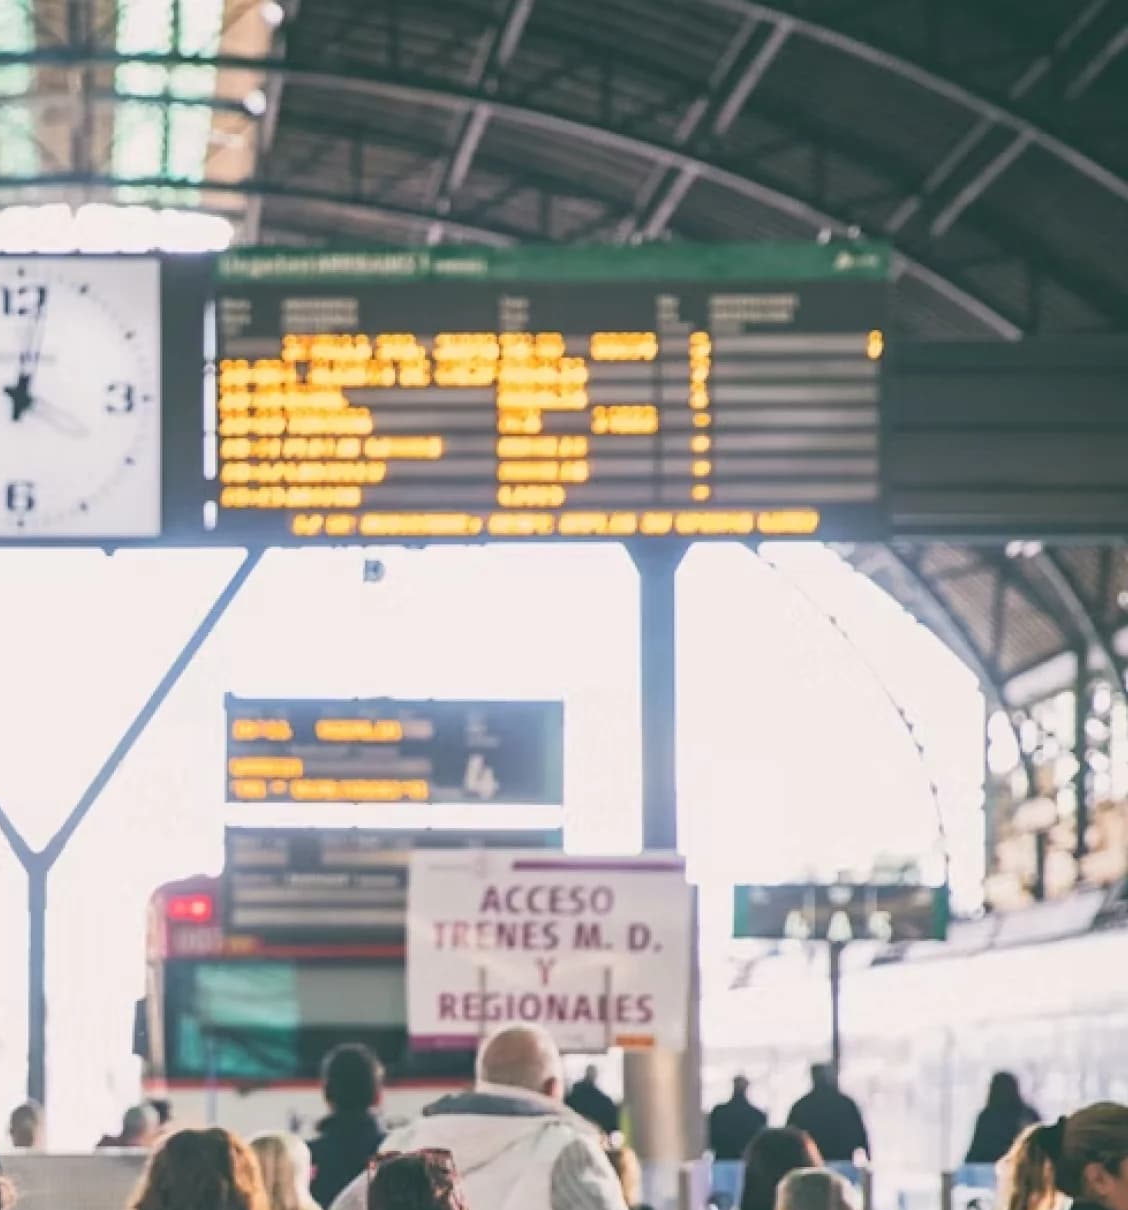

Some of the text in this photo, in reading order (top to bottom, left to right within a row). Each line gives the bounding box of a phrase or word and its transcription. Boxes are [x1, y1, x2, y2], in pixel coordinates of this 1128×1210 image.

[0, 286, 47, 316] 12
[105, 385, 133, 412] 3
[6, 483, 35, 511] 6
[465, 753, 500, 799] 4
[480, 885, 614, 914] ACCESO
[433, 922, 664, 952] TRENES M. D.
[535, 957, 556, 986] Y
[437, 992, 655, 1024] REGIONALES
